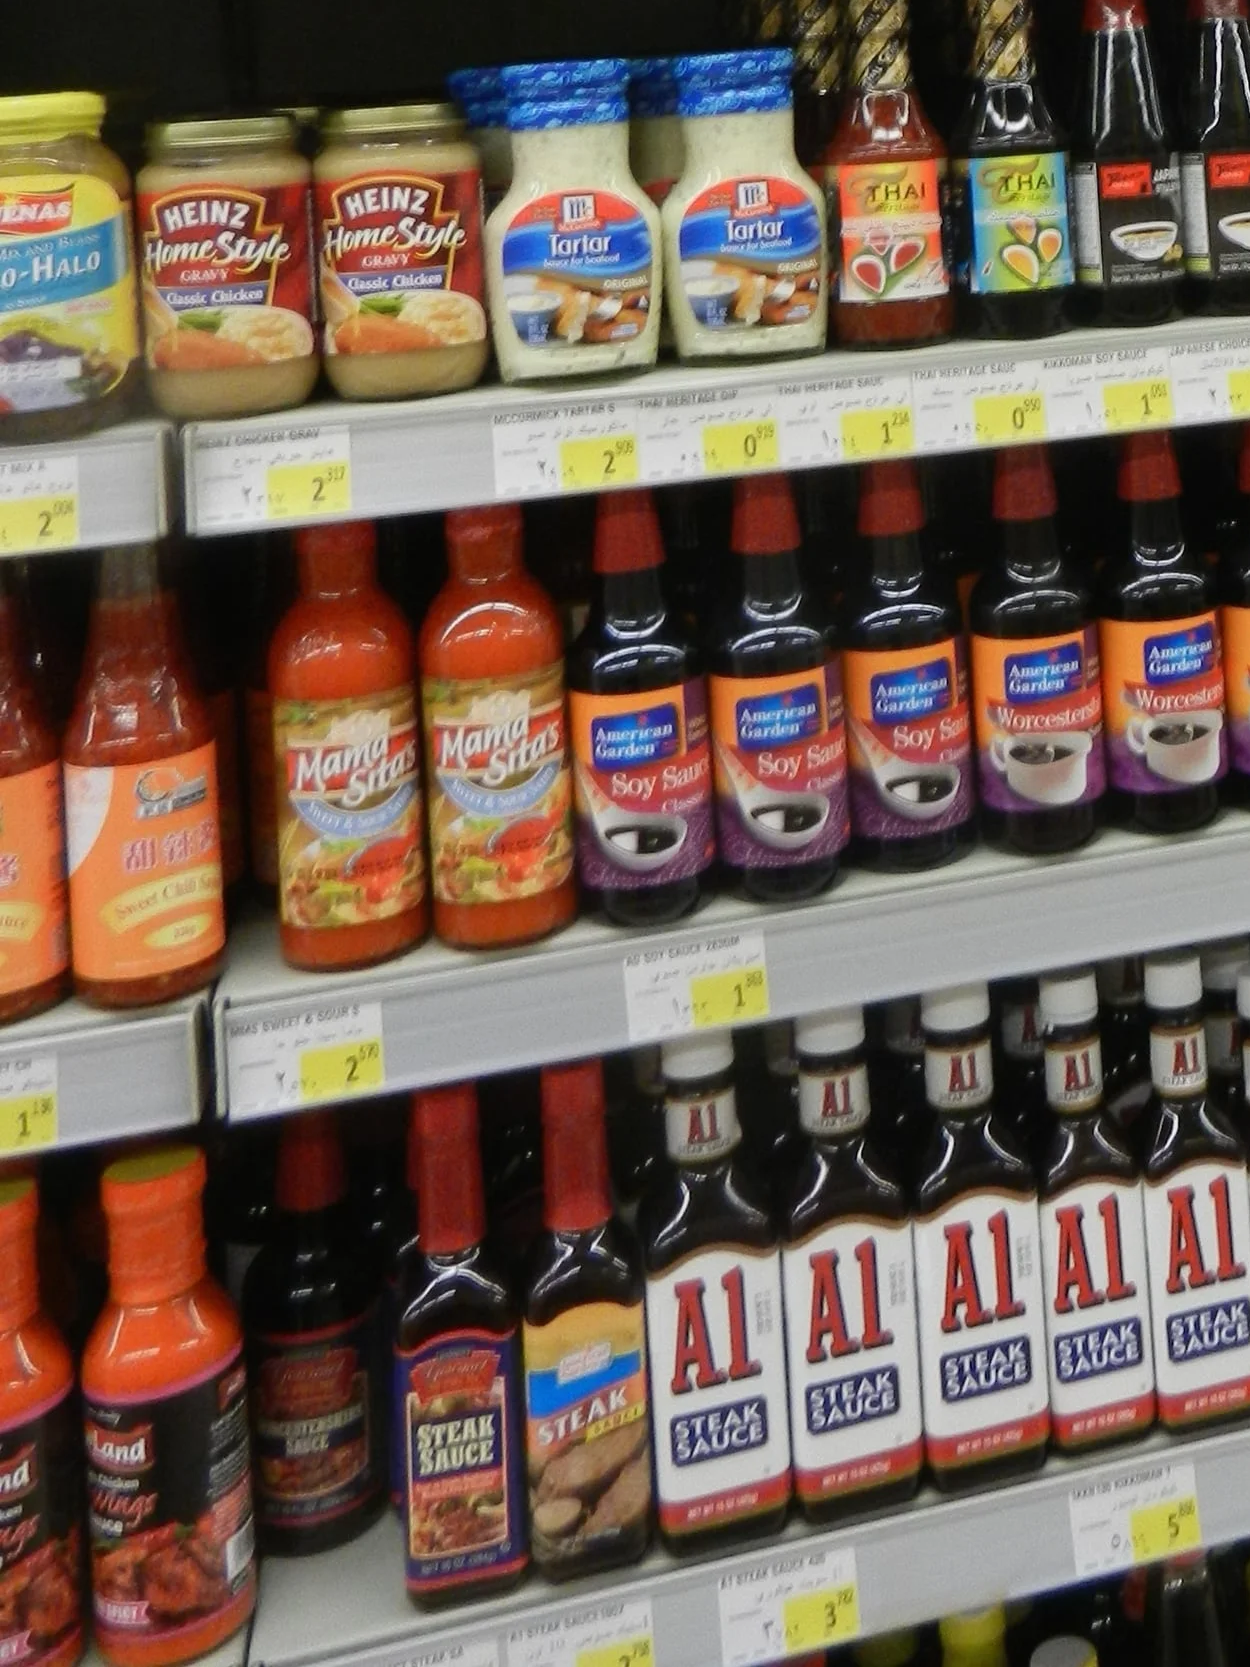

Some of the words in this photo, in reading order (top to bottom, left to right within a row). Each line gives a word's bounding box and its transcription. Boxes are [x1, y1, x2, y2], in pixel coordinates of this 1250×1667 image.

[865, 181, 928, 204] THAI
[1001, 172, 1058, 193] THAI
[345, 185, 429, 216] HEINZ
[163, 199, 252, 230] HEINZ
[725, 216, 785, 244] Tartar
[548, 230, 613, 258] Tartar
[361, 253, 411, 269] GRAVY
[180, 268, 230, 284] GRAVY
[347, 275, 390, 292] Classic
[391, 271, 443, 289] Chicken
[165, 289, 208, 306] Classic
[210, 286, 264, 304] Chicken
[1012, 406, 1025, 429] 0
[744, 434, 757, 459] 0
[603, 449, 617, 475] 2
[312, 477, 326, 503] 2
[1148, 638, 1213, 662] American
[1008, 658, 1080, 681] American
[1149, 656, 1202, 676] Garden
[875, 675, 949, 699] American
[1009, 675, 1066, 695] Garden
[739, 700, 818, 725] American
[875, 692, 933, 714] Garden
[440, 708, 530, 768] Mama
[594, 722, 674, 745] American
[739, 719, 801, 741] Garden
[892, 723, 935, 750] Soy
[294, 733, 390, 791] Mama
[489, 719, 558, 788] Sita's
[595, 739, 657, 760] Garden
[345, 742, 417, 810] Sita's
[757, 751, 802, 778] Soy
[610, 772, 657, 801] Soy
[346, 1054, 359, 1083] 2
[1168, 1303, 1248, 1339] STEAK
[1058, 1323, 1138, 1360] STEAK
[944, 1339, 1026, 1378] STEAK
[1061, 1340, 1141, 1379] SAUCE
[810, 1371, 893, 1414] STEAK
[945, 1360, 1029, 1399] SAUCE
[537, 1386, 627, 1447] STEAK
[674, 1400, 762, 1441] STEAK
[810, 1391, 897, 1432] SAUCE
[416, 1413, 496, 1451] STEAK
[675, 1422, 764, 1461] SAUCE
[418, 1440, 495, 1476] SAUCE
